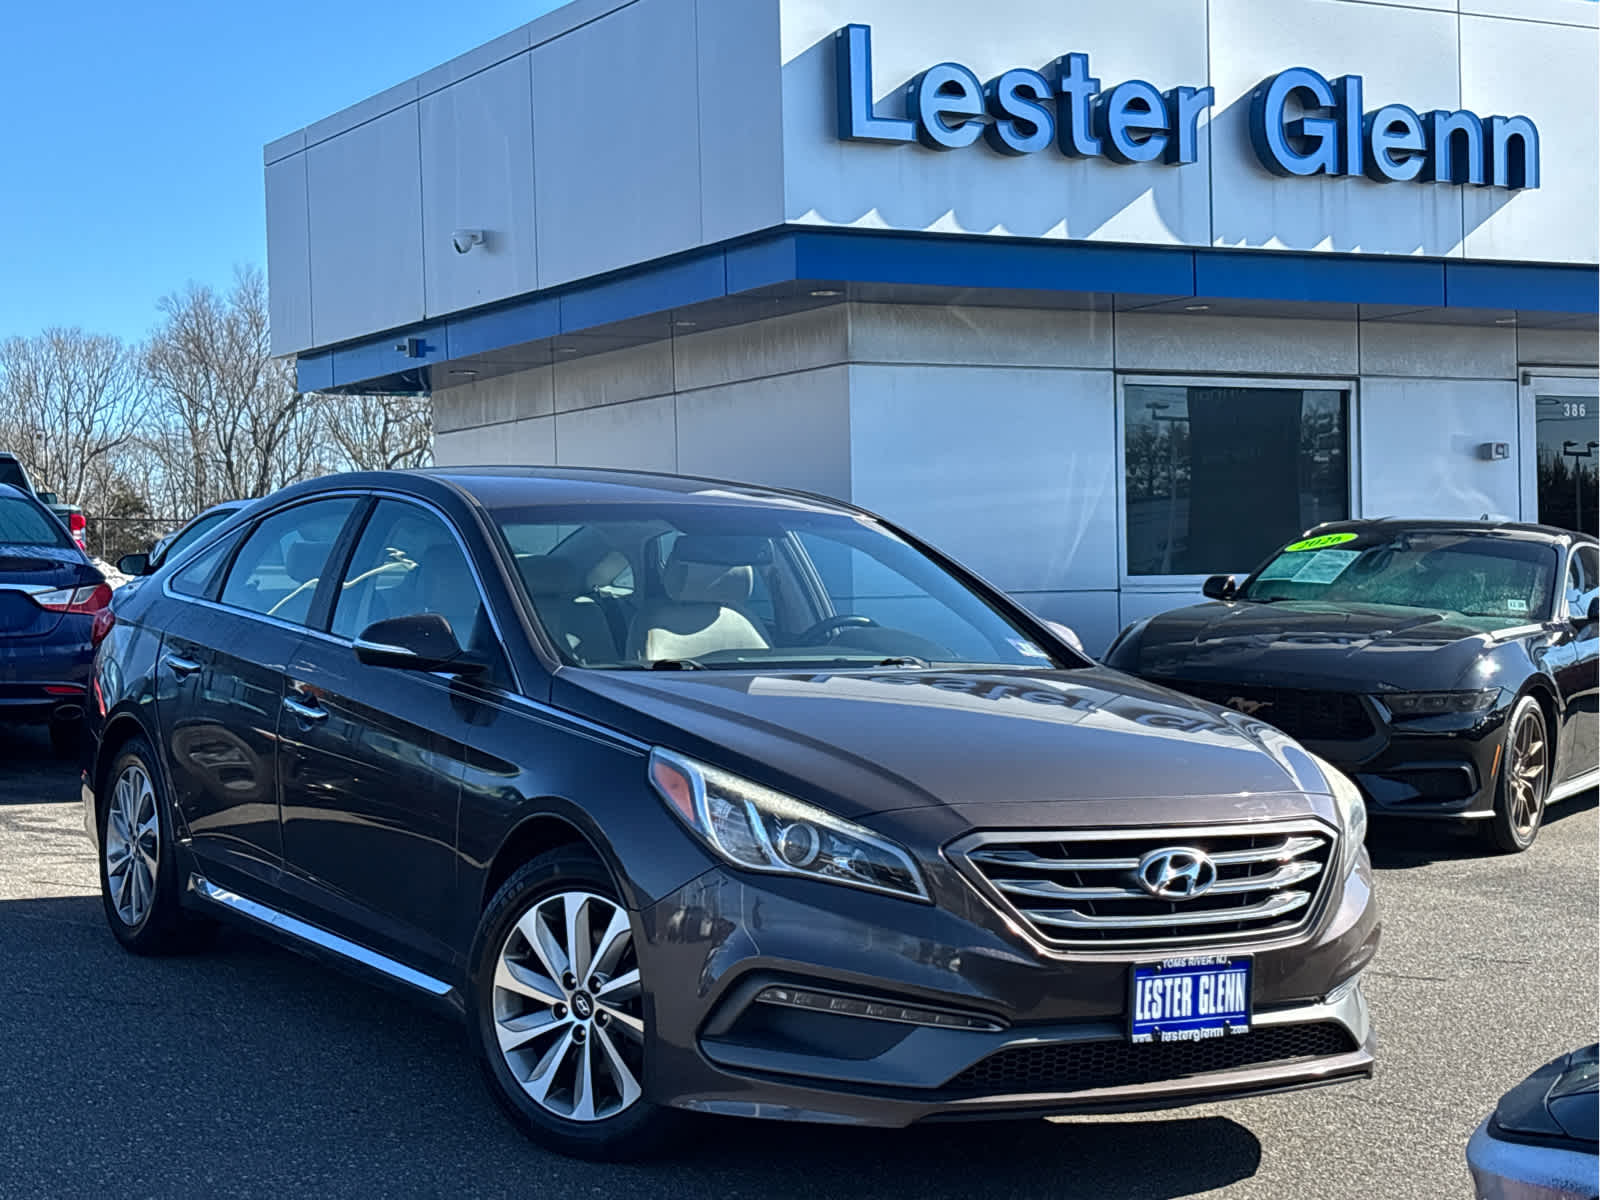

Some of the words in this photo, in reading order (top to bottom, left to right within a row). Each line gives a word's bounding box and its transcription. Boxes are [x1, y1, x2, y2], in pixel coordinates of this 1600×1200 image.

[836, 24, 1214, 166] Lester
[1250, 67, 1541, 190] Glenn
[1563, 403, 1586, 417] 386
[1162, 958, 1186, 969] TOMS
[1215, 954, 1228, 965] NJ
[1136, 977, 1193, 1021] LESTER
[1199, 973, 1247, 1015] GLENN
